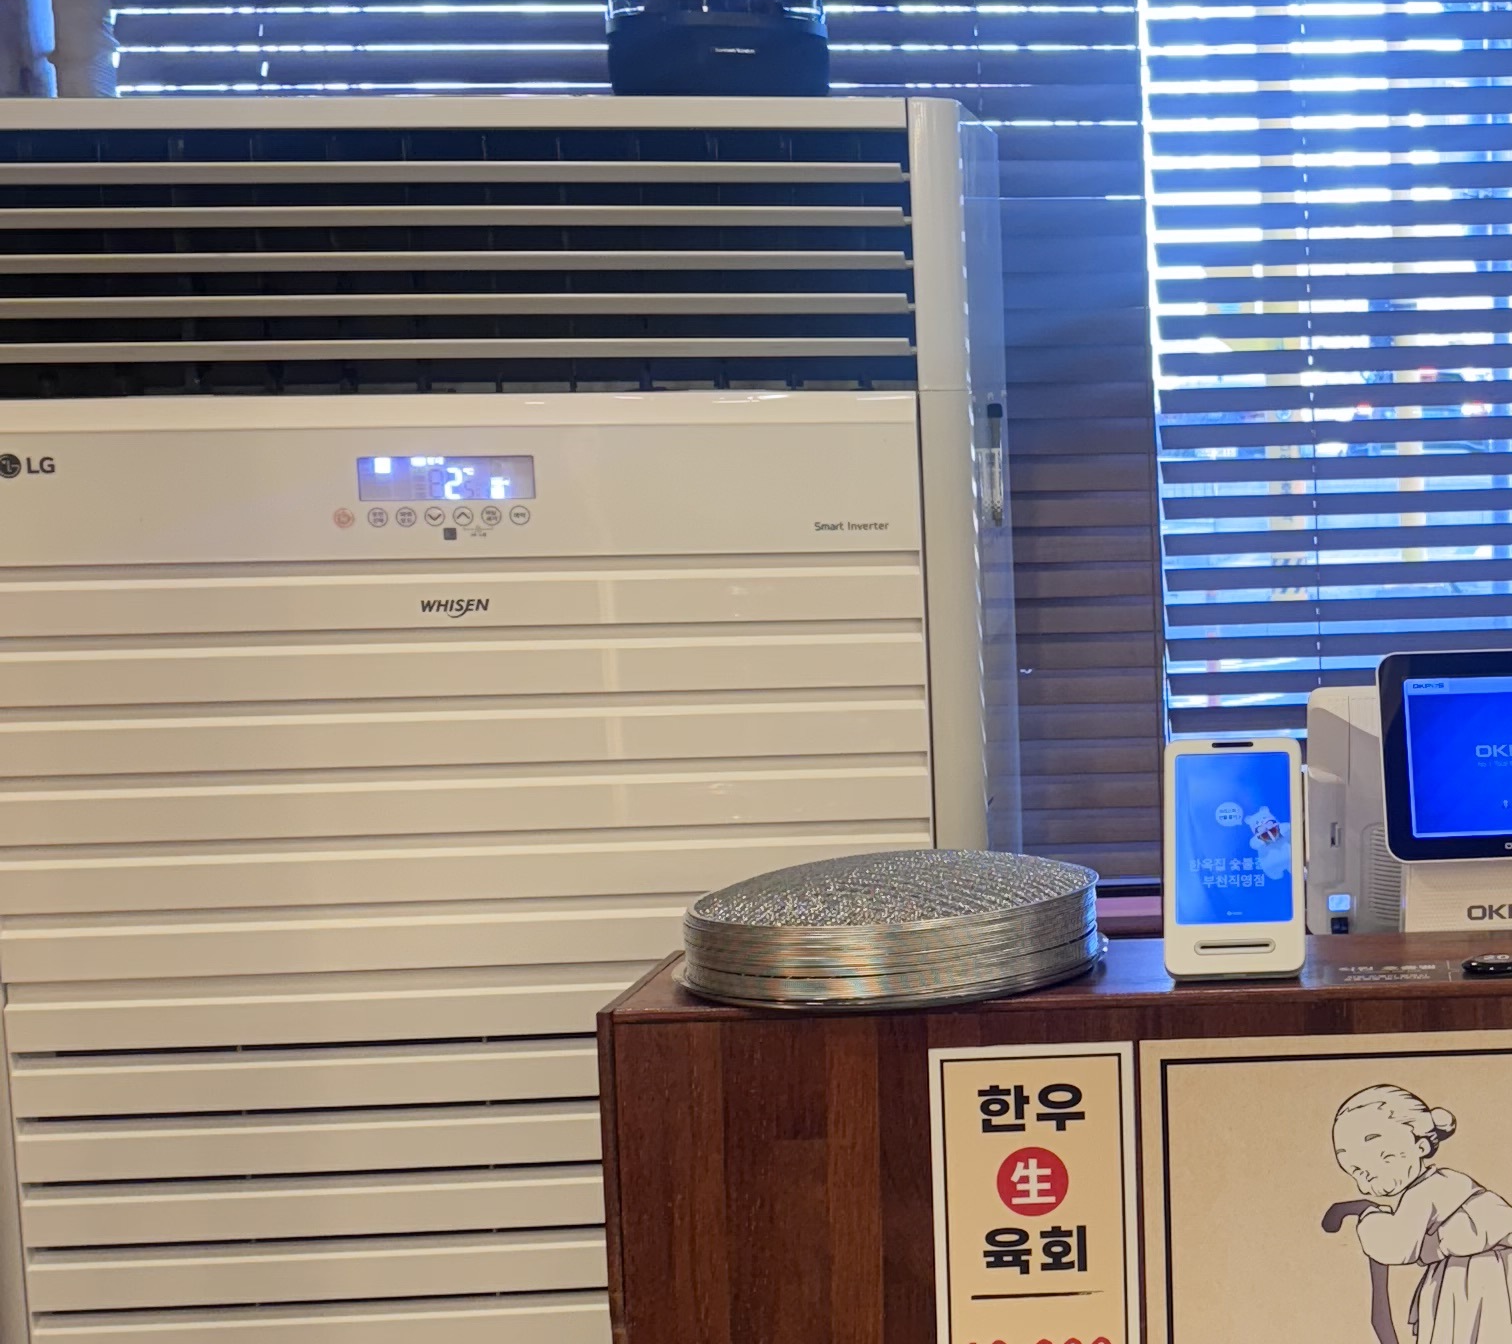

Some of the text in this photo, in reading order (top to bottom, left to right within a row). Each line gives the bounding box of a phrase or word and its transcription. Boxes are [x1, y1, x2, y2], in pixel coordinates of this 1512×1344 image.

[26, 457, 55, 474] LG
[814, 521, 889, 531] Smart Inverter
[420, 598, 490, 618] WHISEN
[977, 1083, 1086, 1134] 한우
[1010, 1157, 1057, 1207] 生
[982, 1225, 1089, 1277] 육회
